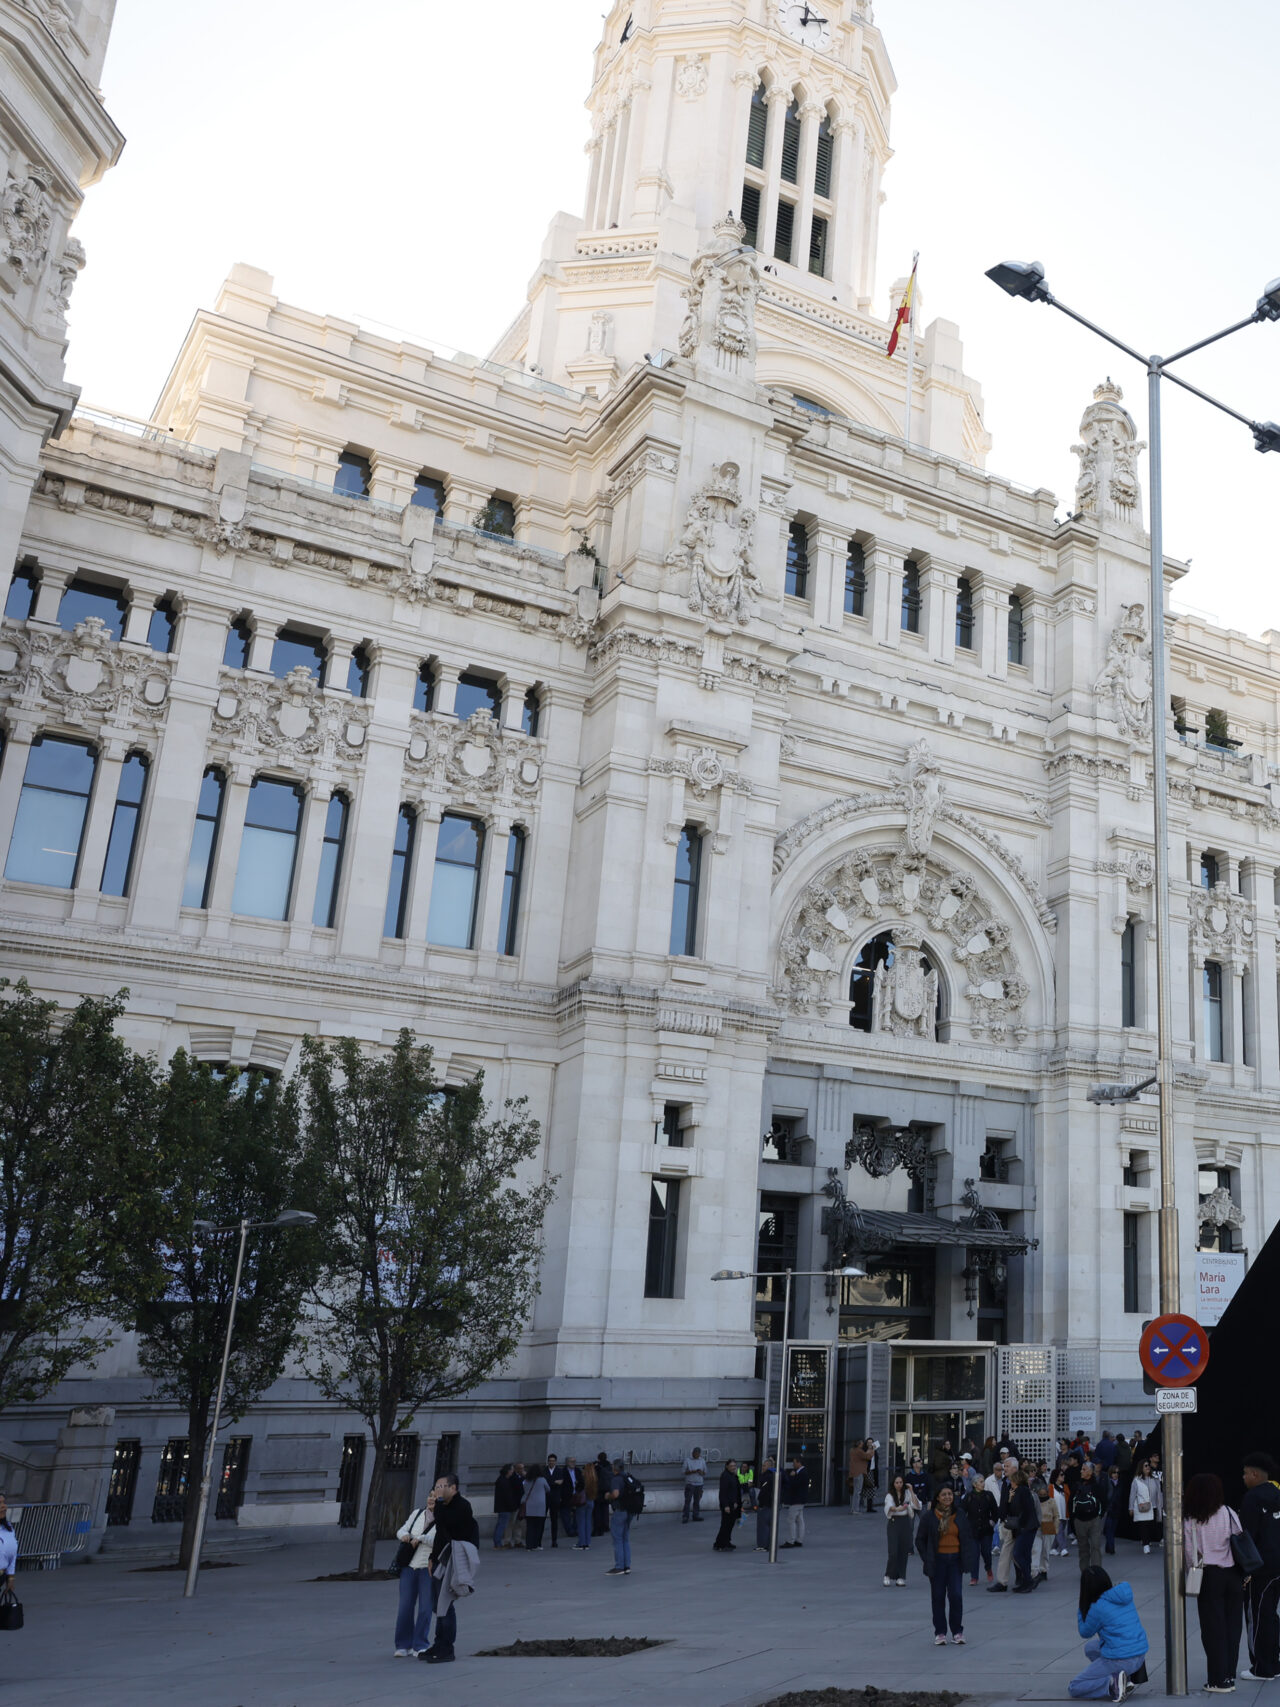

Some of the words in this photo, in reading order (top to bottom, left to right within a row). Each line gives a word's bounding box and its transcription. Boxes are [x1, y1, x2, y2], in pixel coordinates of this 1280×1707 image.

[1200, 1284, 1220, 1294] Lara
[1162, 1392, 1180, 1400] ZONA
[1180, 1391, 1190, 1399] DE
[1158, 1401, 1194, 1410] SEGURIDAD
